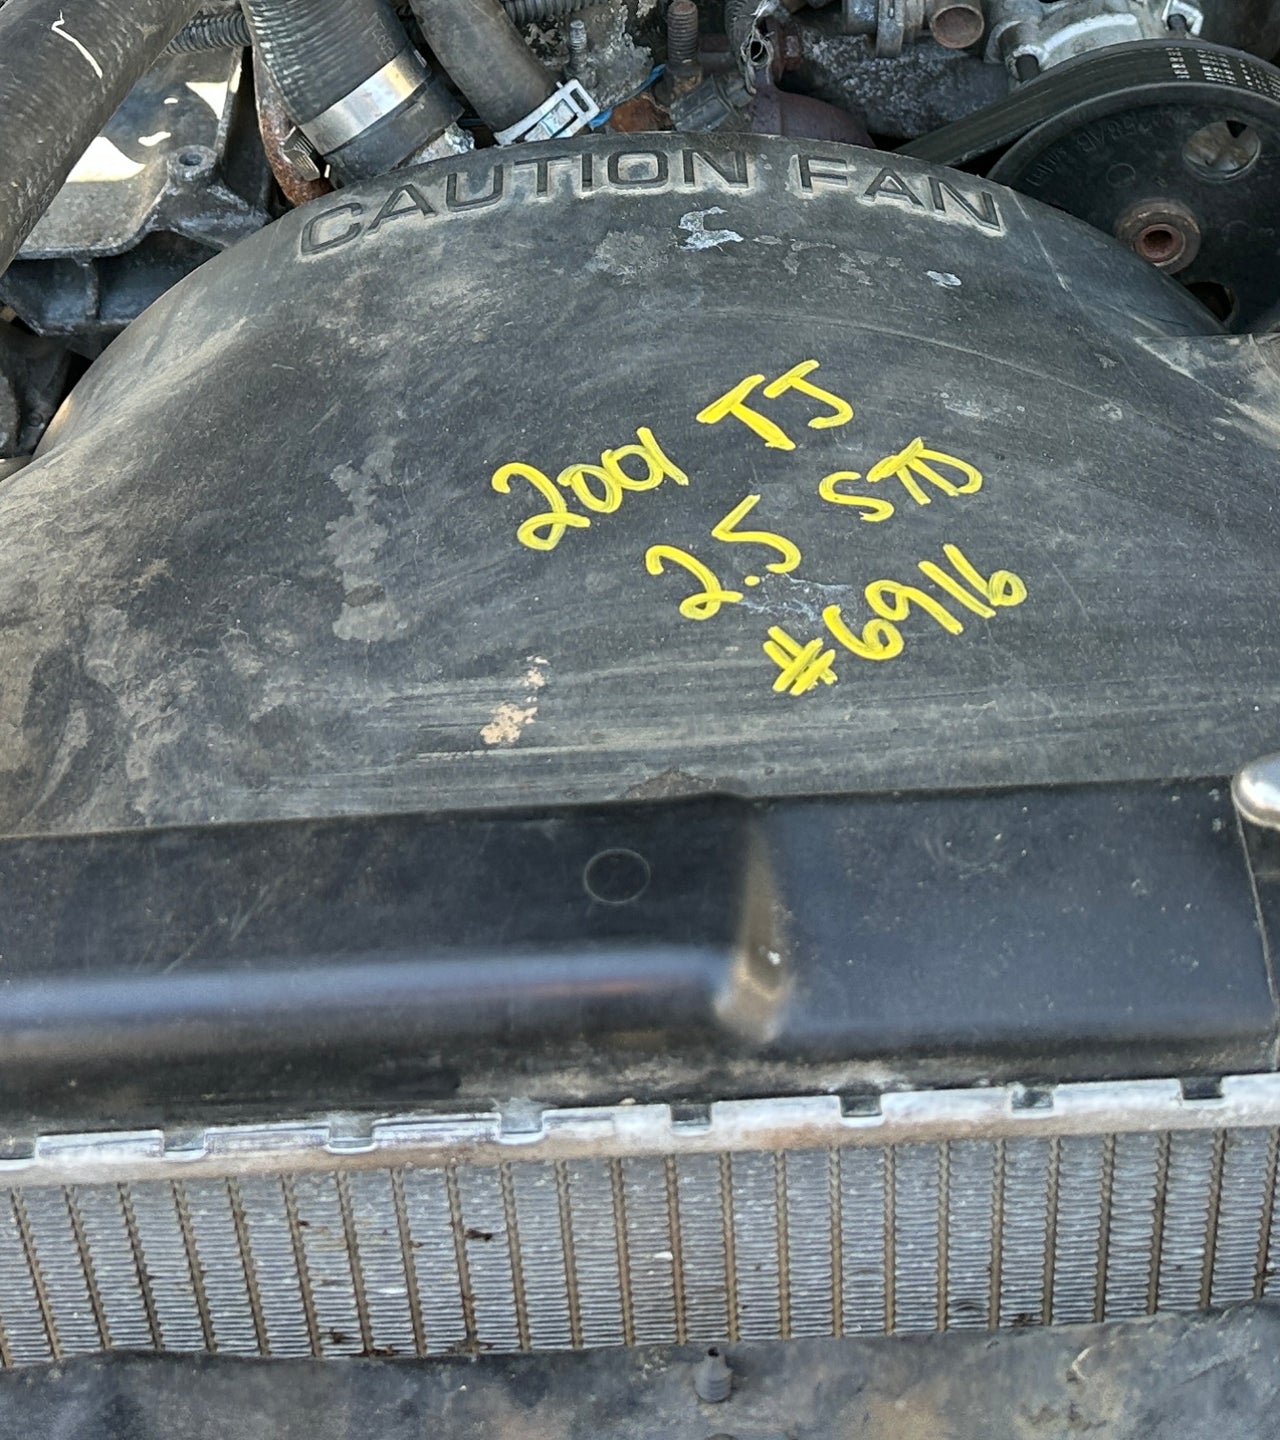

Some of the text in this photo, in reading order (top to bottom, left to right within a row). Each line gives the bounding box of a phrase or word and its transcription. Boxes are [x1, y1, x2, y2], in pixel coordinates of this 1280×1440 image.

[299, 148, 1004, 258] CAUTION FAN
[492, 360, 854, 551] 2001 TJ
[646, 436, 983, 620] 2.5 STD
[762, 544, 1027, 696] #6916
